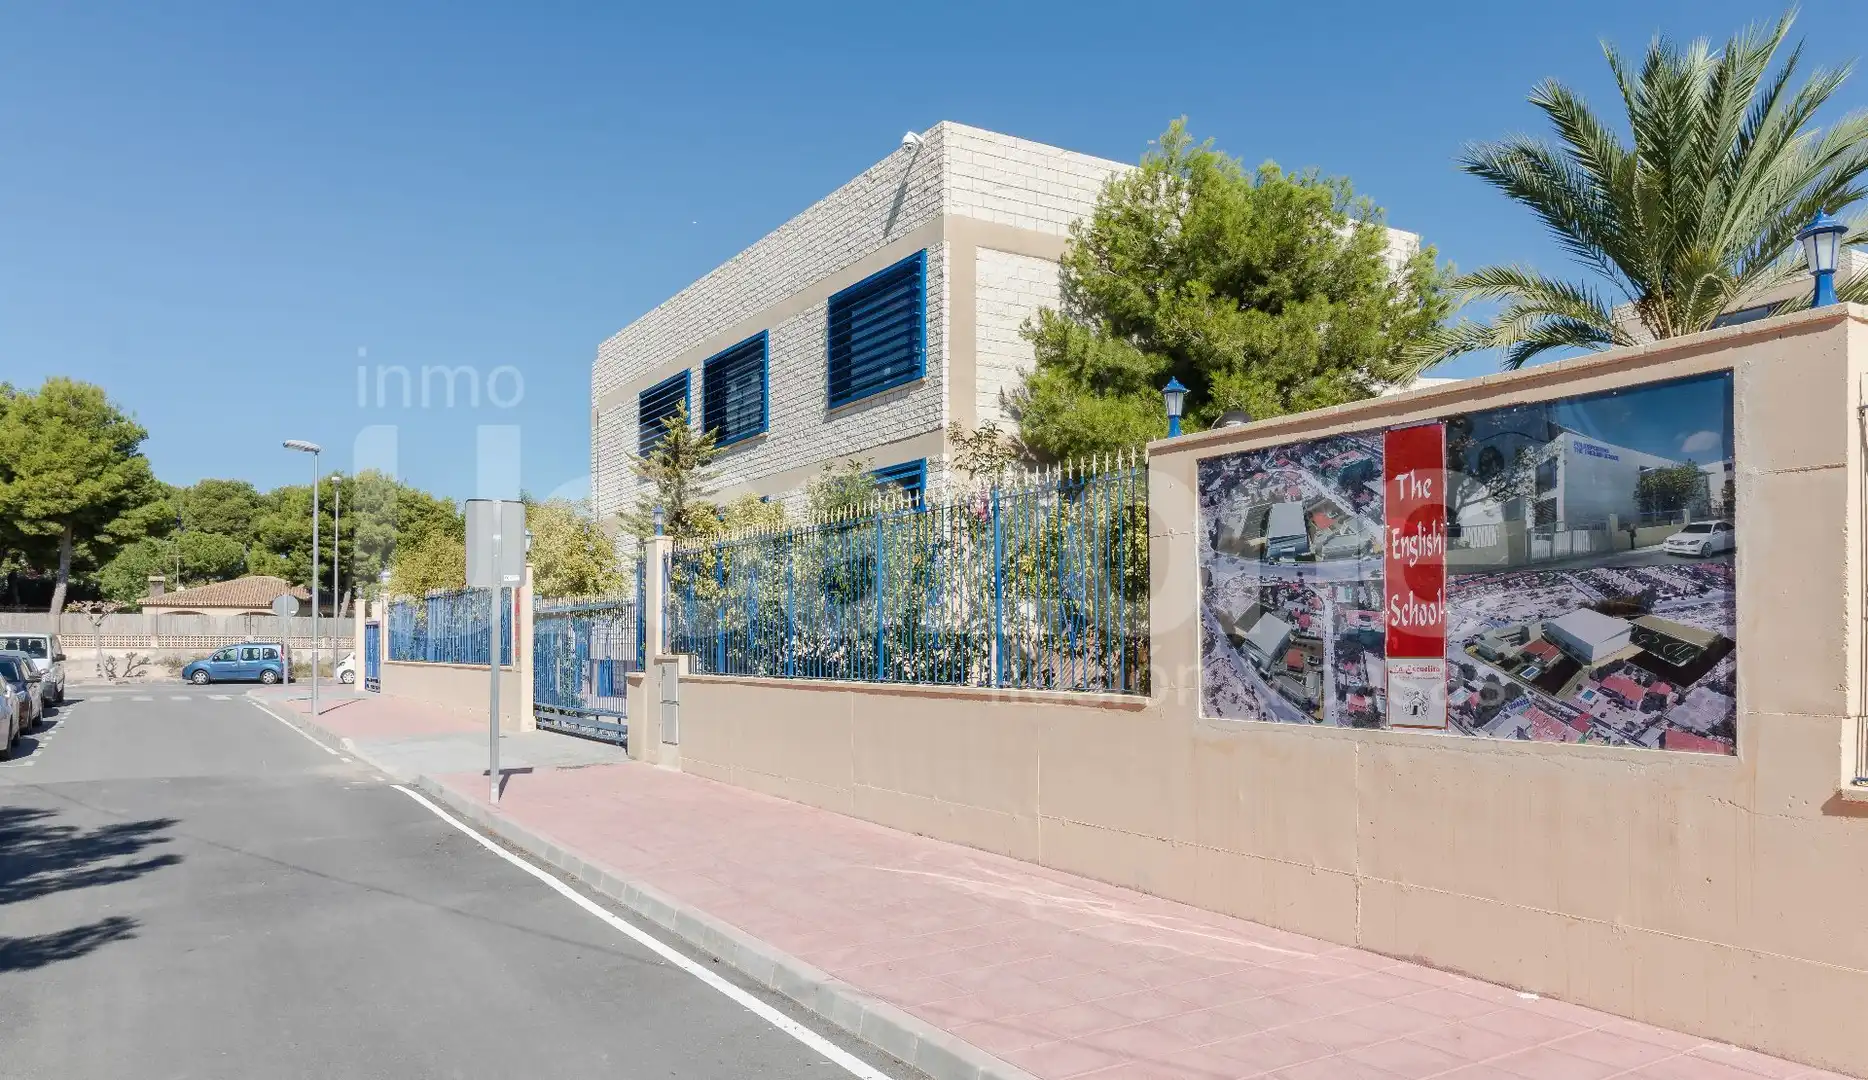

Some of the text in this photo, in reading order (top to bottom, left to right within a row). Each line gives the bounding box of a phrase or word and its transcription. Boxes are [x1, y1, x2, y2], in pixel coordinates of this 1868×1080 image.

[1395, 468, 1432, 501] The
[1391, 520, 1442, 567] English
[1390, 588, 1442, 628] School
